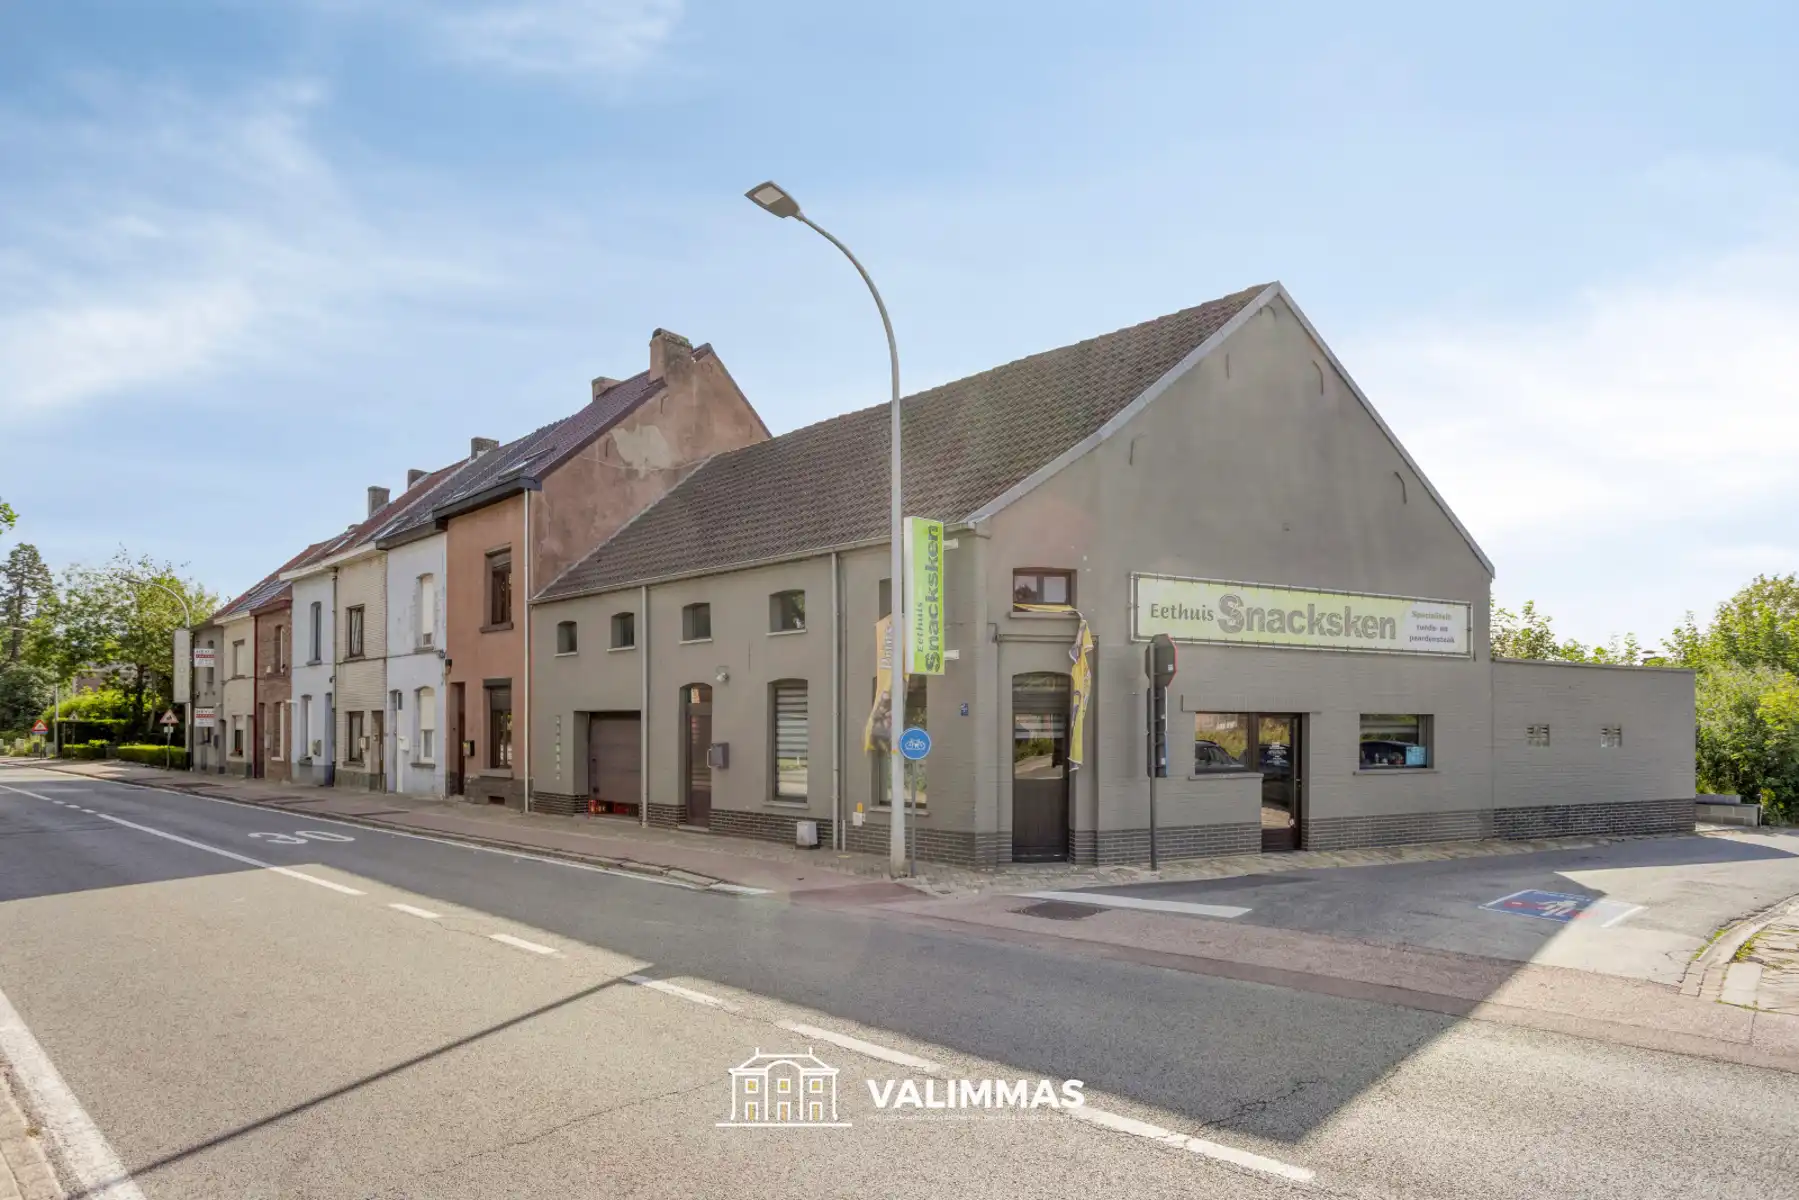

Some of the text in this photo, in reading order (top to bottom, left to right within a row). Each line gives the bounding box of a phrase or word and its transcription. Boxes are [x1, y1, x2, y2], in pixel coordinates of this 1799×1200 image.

[925, 525, 940, 672] Snacksken
[1150, 593, 1396, 640] Eethuis Snacksken
[916, 602, 924, 653] Eethuis
[247, 830, 356, 845] 30
